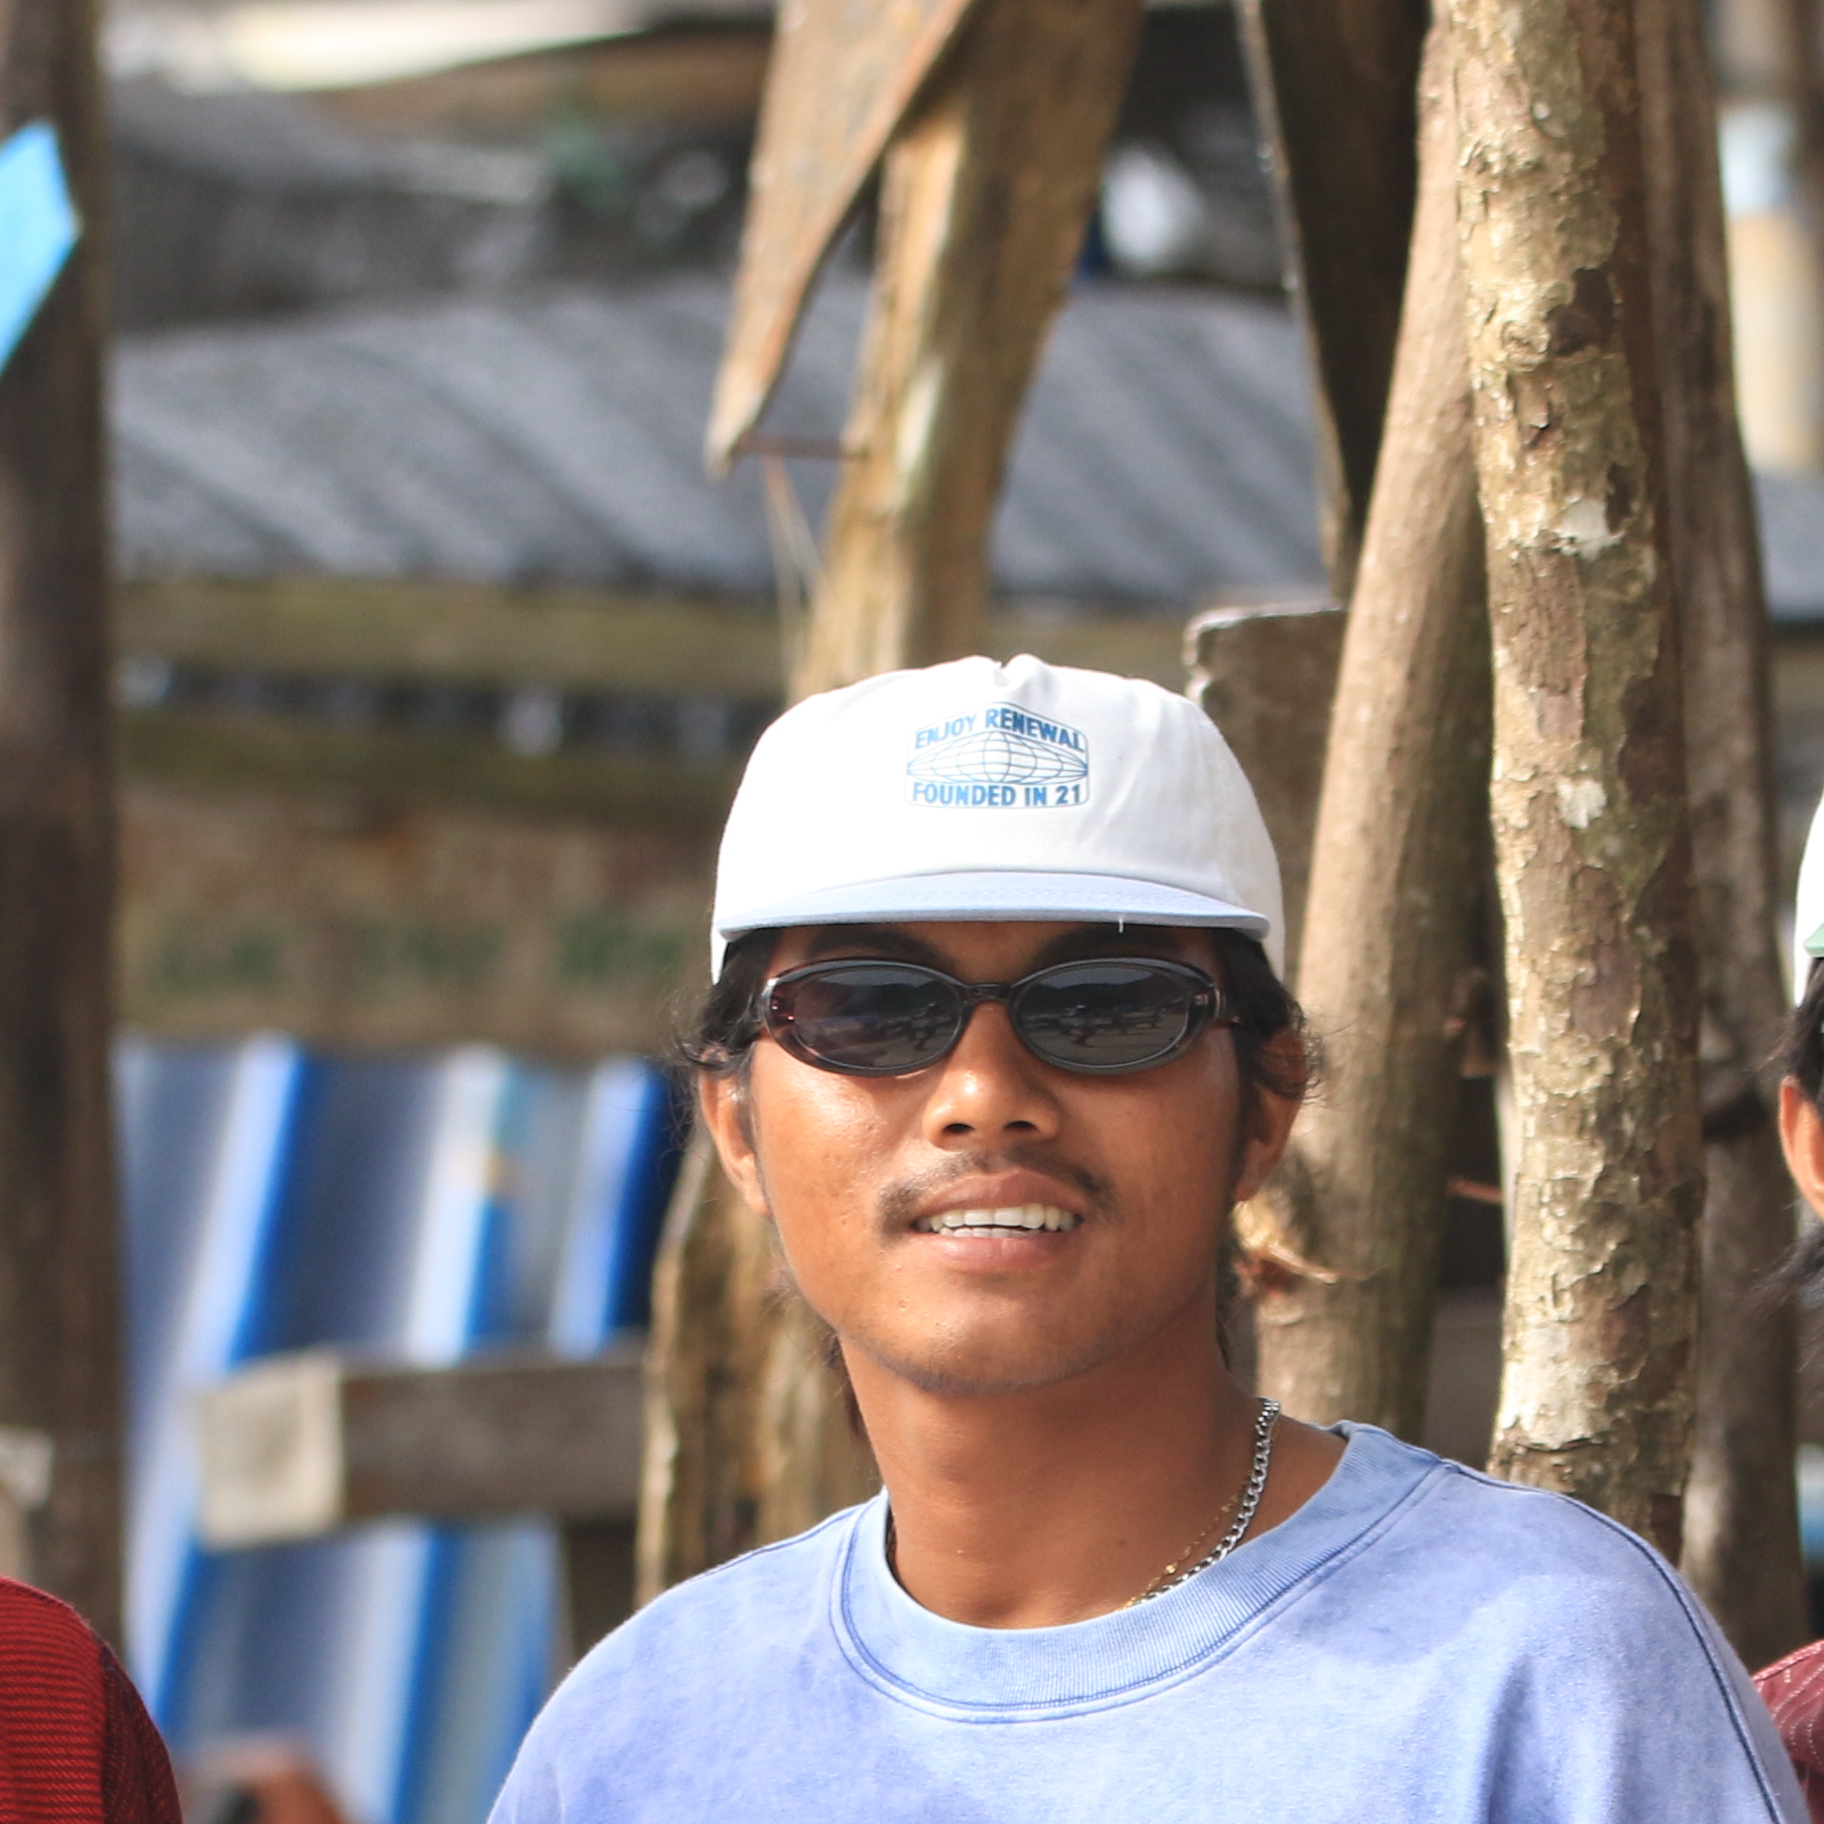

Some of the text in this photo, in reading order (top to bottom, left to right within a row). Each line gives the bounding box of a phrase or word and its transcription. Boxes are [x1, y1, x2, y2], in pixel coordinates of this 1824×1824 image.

[914, 707, 1085, 753] ENJOY RENEWAL
[912, 781, 1082, 807] FOUNDED IN 21
